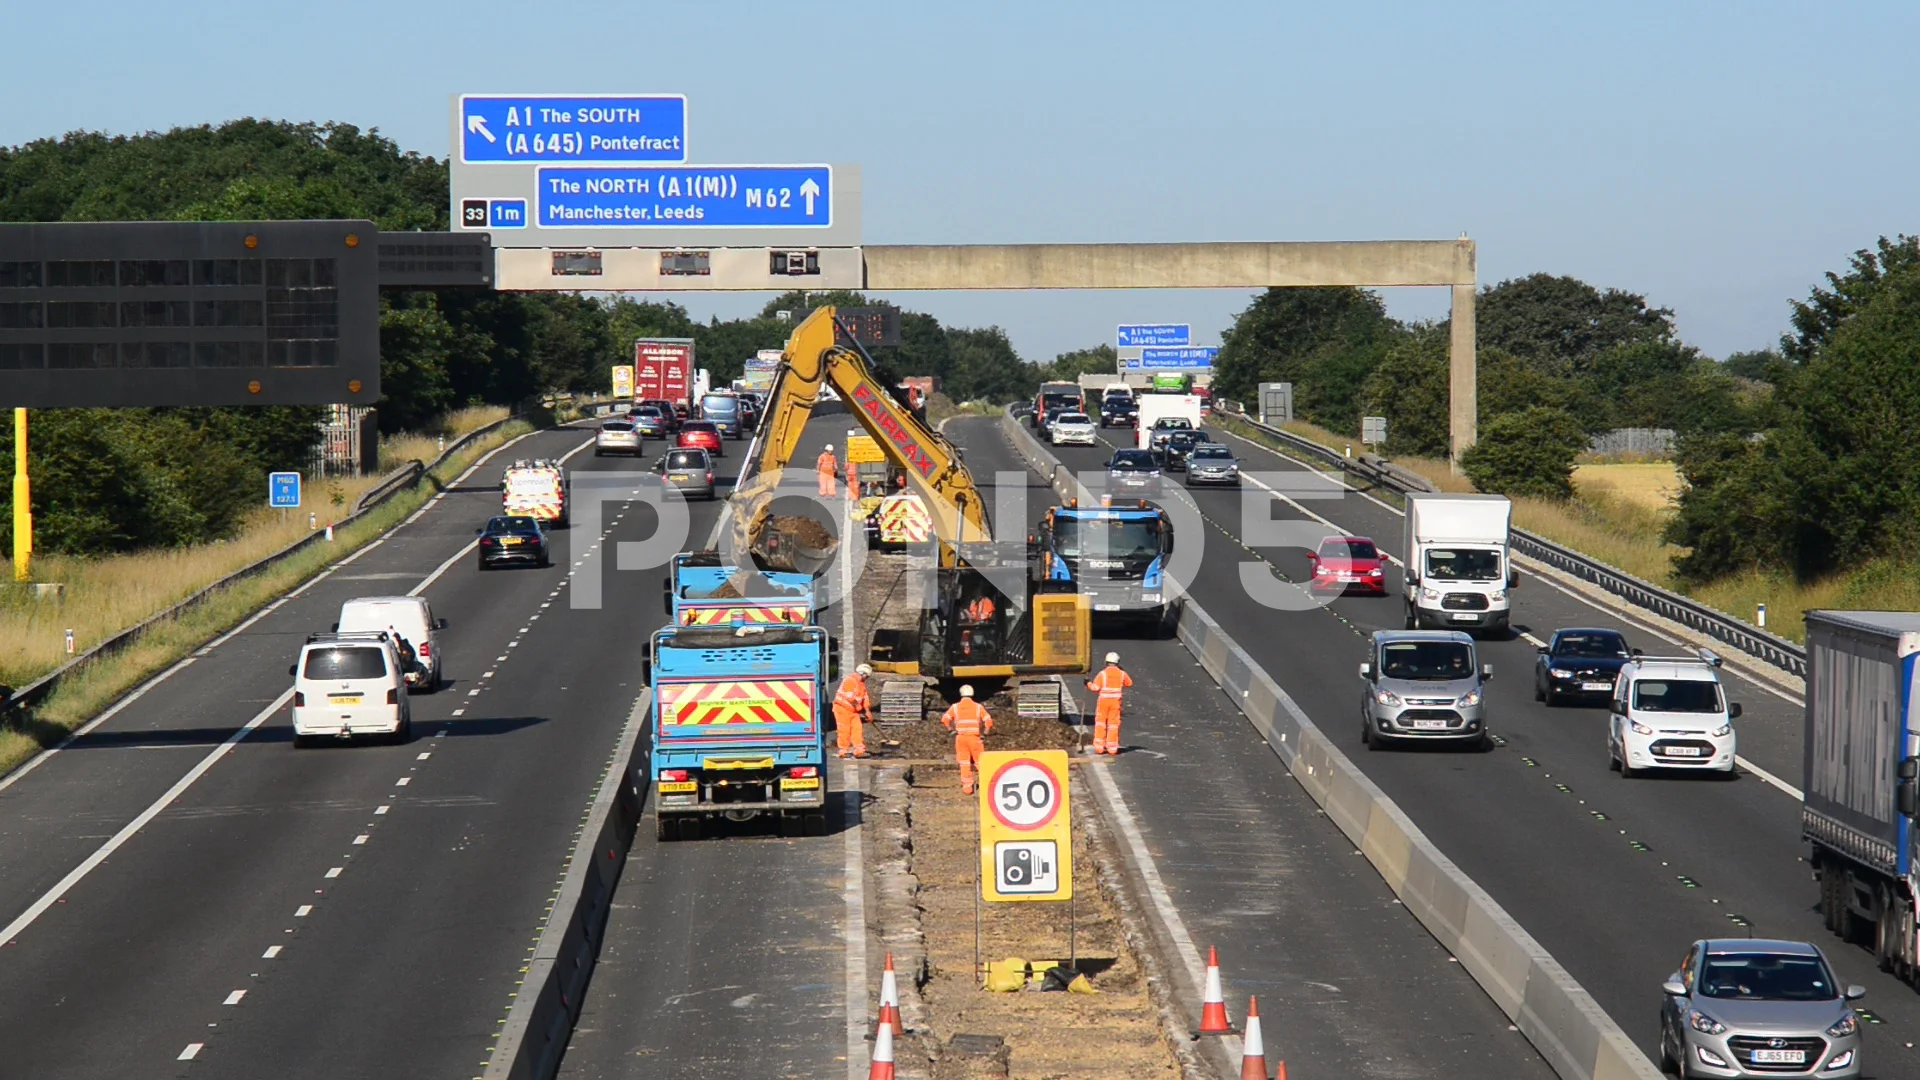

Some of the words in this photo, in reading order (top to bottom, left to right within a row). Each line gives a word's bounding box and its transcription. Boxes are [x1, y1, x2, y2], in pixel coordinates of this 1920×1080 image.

[539, 108, 571, 123] The
[577, 108, 641, 123] SOUTH
[505, 131, 583, 155] (A645)
[590, 135, 680, 150] Pontefract
[549, 178, 580, 193] The
[586, 178, 650, 193] NORTH
[745, 187, 791, 208] M62
[465, 208, 484, 220] 33
[495, 205, 519, 220] 1m
[549, 204, 651, 220] Manchester,
[654, 204, 704, 219] Leeds
[854, 385, 934, 478] FAIRFAX
[1089, 561, 1125, 569] SCANIA
[1002, 779, 1050, 812] 50
